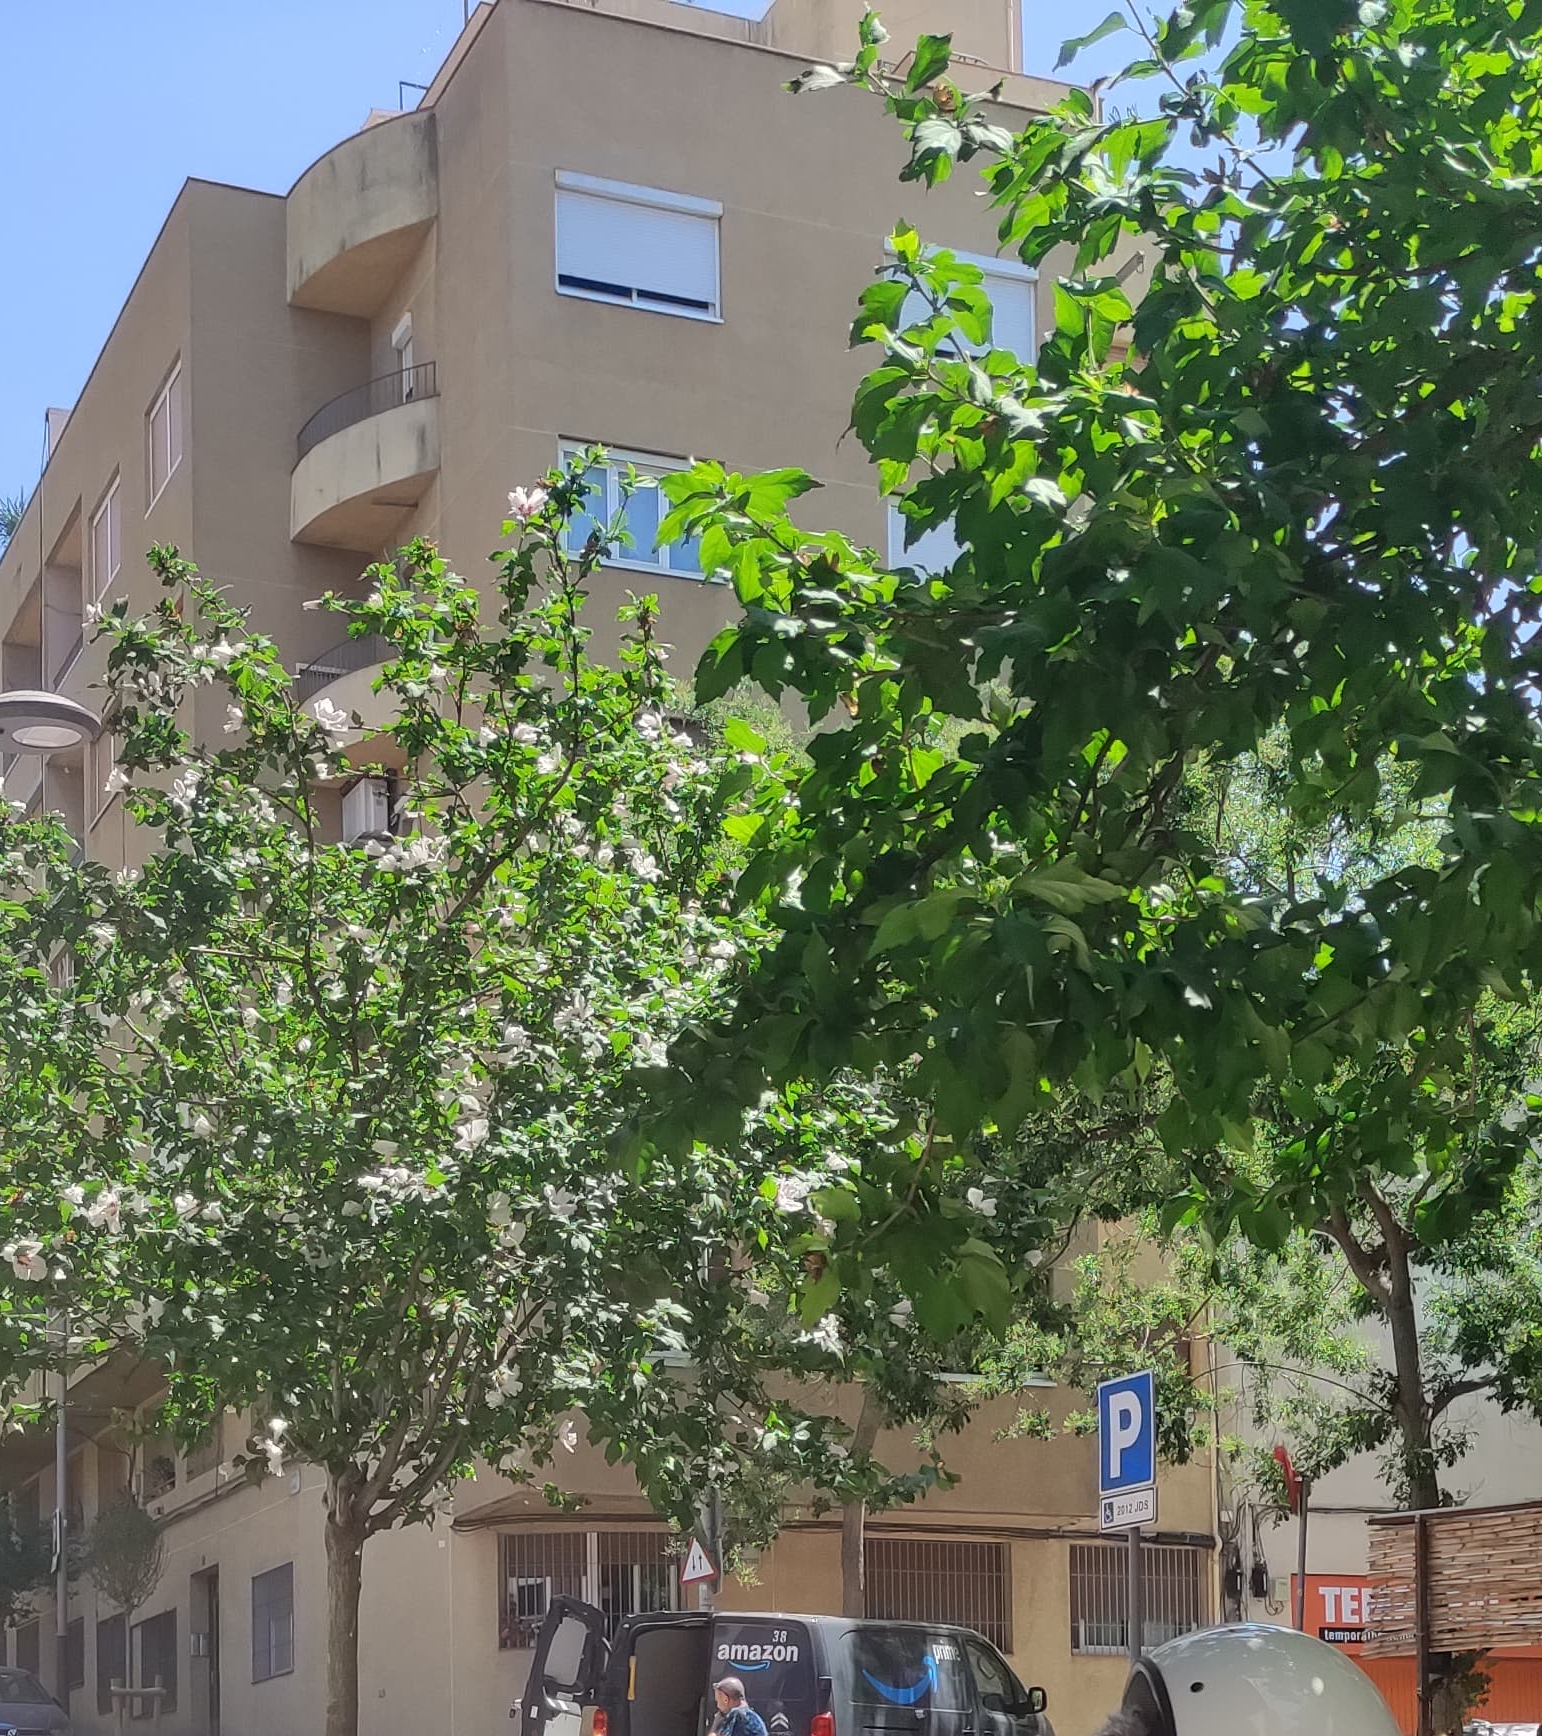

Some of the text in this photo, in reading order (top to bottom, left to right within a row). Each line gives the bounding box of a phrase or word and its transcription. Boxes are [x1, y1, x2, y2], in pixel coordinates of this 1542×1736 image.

[1109, 1390, 1142, 1479] P
[1116, 1503, 1133, 1515] 2012
[772, 1630, 787, 1643] 38
[717, 1644, 799, 1662] amazon
